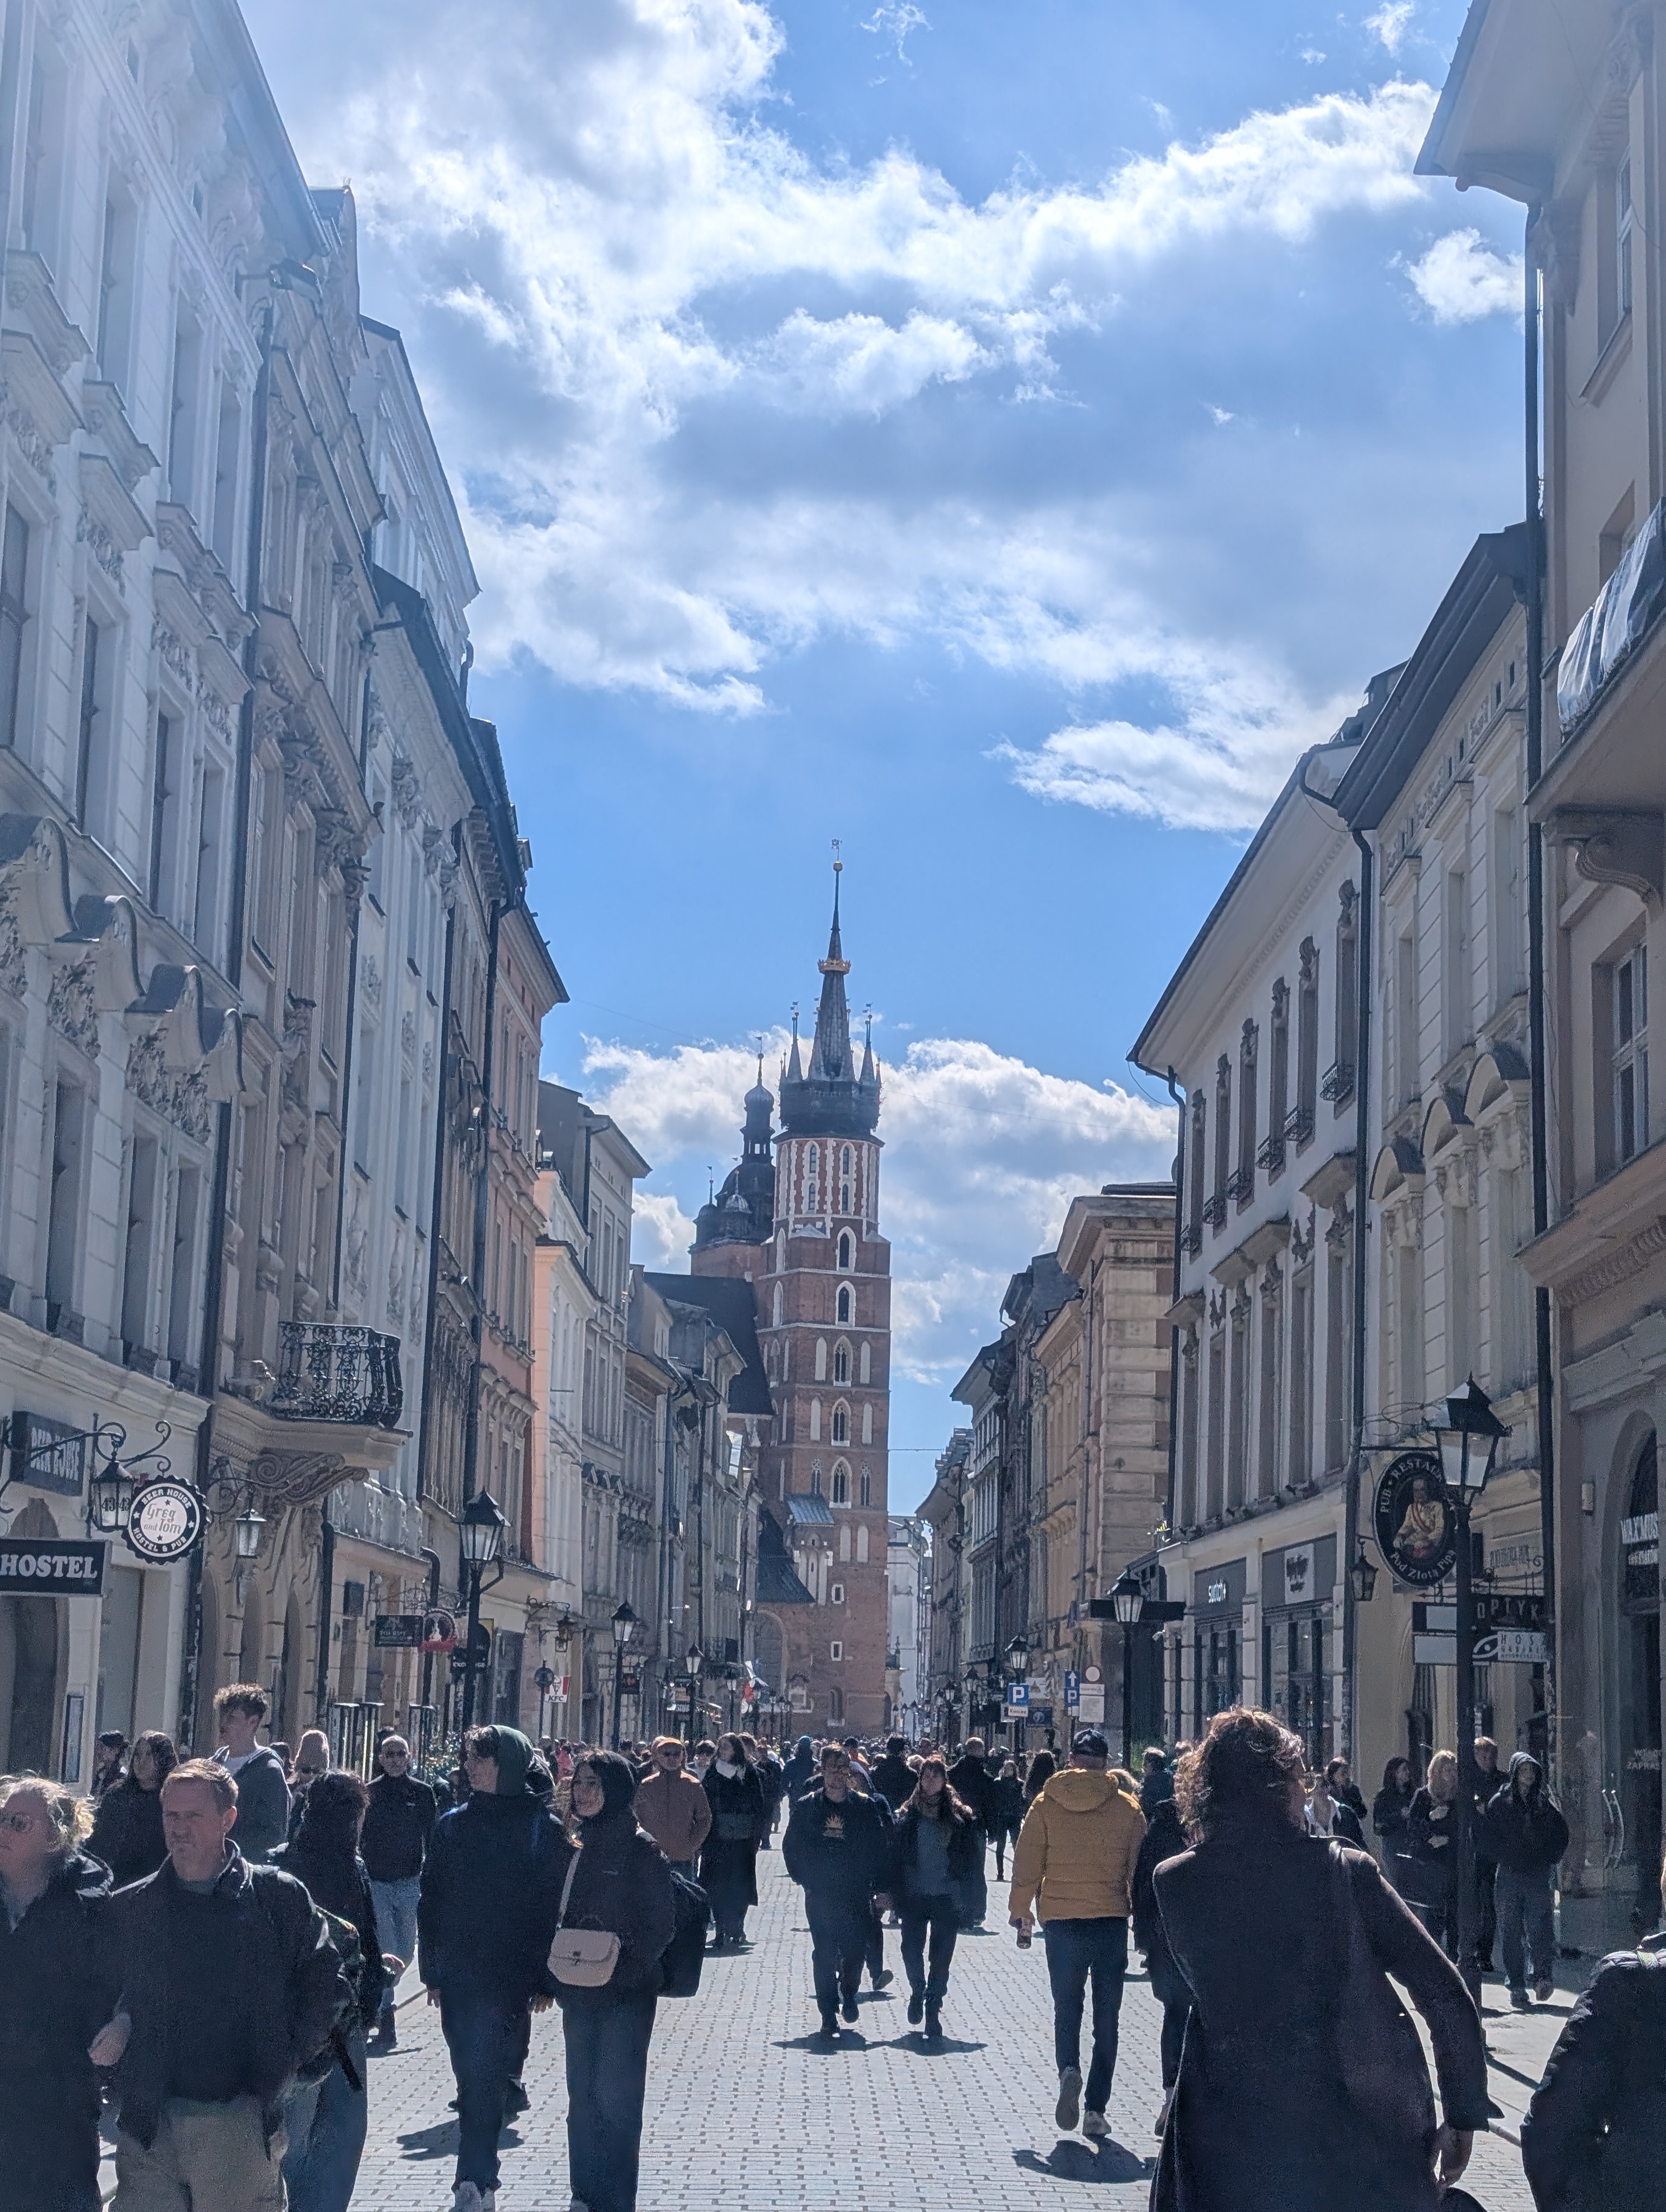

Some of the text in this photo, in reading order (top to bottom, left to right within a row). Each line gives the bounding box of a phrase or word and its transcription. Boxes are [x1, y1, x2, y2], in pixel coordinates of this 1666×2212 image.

[102, 1497, 116, 1512] 43
[119, 1497, 130, 1512] 43
[141, 1489, 191, 1509] BEER HOUSE
[146, 1503, 176, 1522] Greg
[158, 1518, 181, 1534] Tom
[133, 1528, 158, 1552] HOSTEL
[171, 1536, 187, 1549] PUB
[0, 1553, 98, 1578] HOSTEL
[1013, 1687, 1024, 1702] P
[1068, 1690, 1077, 1703] P
